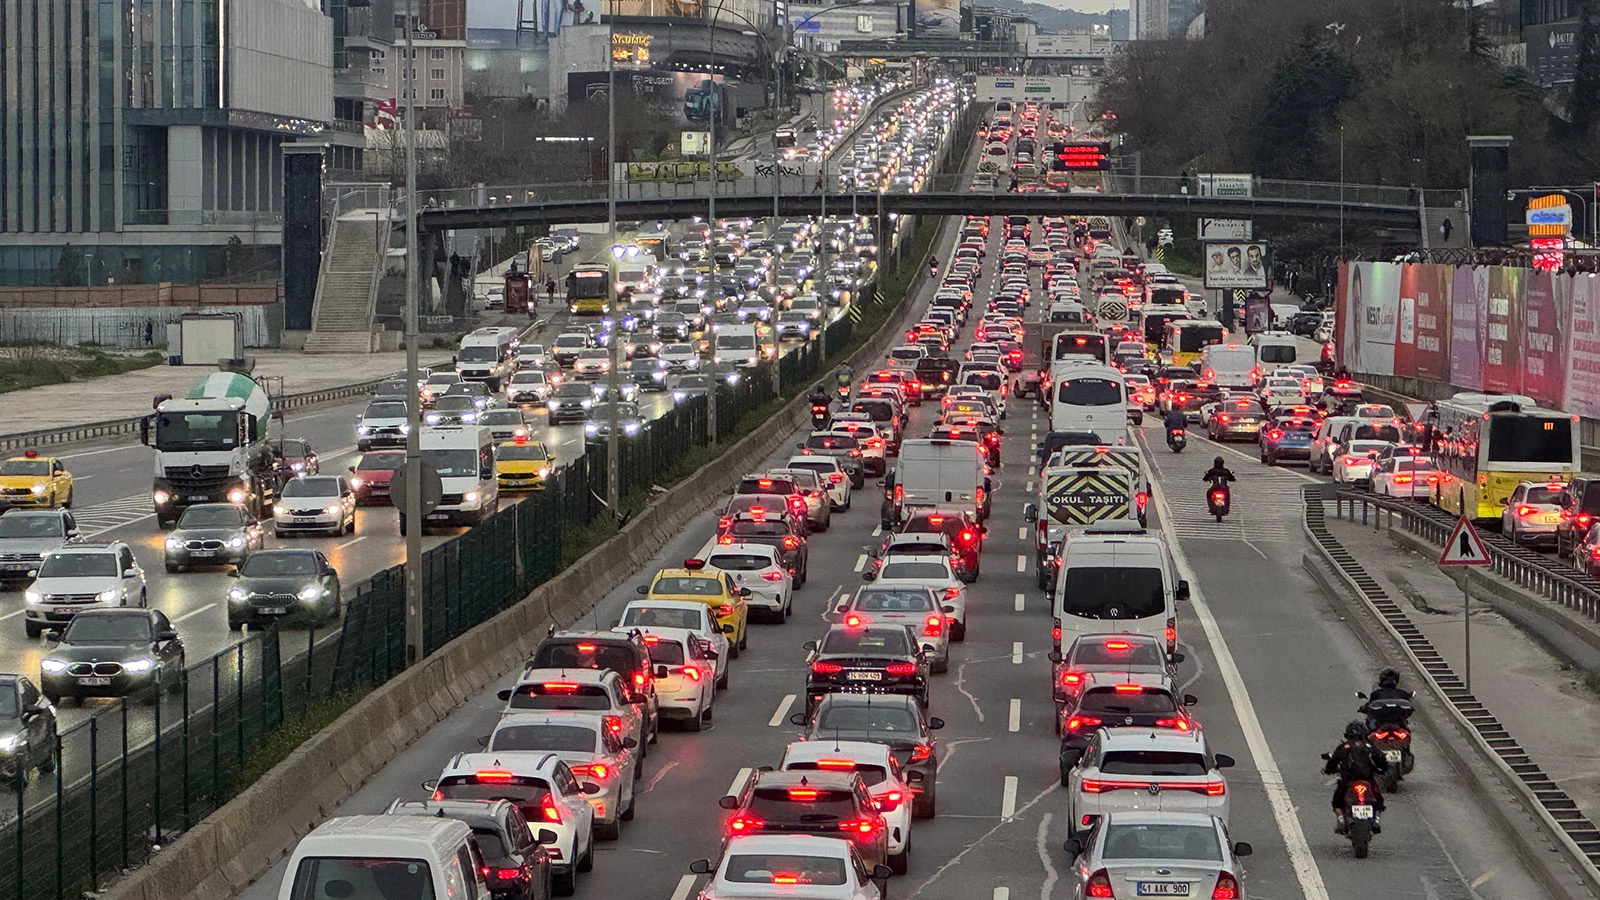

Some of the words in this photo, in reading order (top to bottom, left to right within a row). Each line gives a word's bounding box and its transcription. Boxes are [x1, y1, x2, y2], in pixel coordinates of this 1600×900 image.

[1052, 496, 1084, 504] OKUL
[1089, 495, 1124, 504] TAŞITI
[1142, 884, 1151, 893] 41
[1154, 884, 1168, 893] AAK
[1172, 884, 1187, 893] 900
